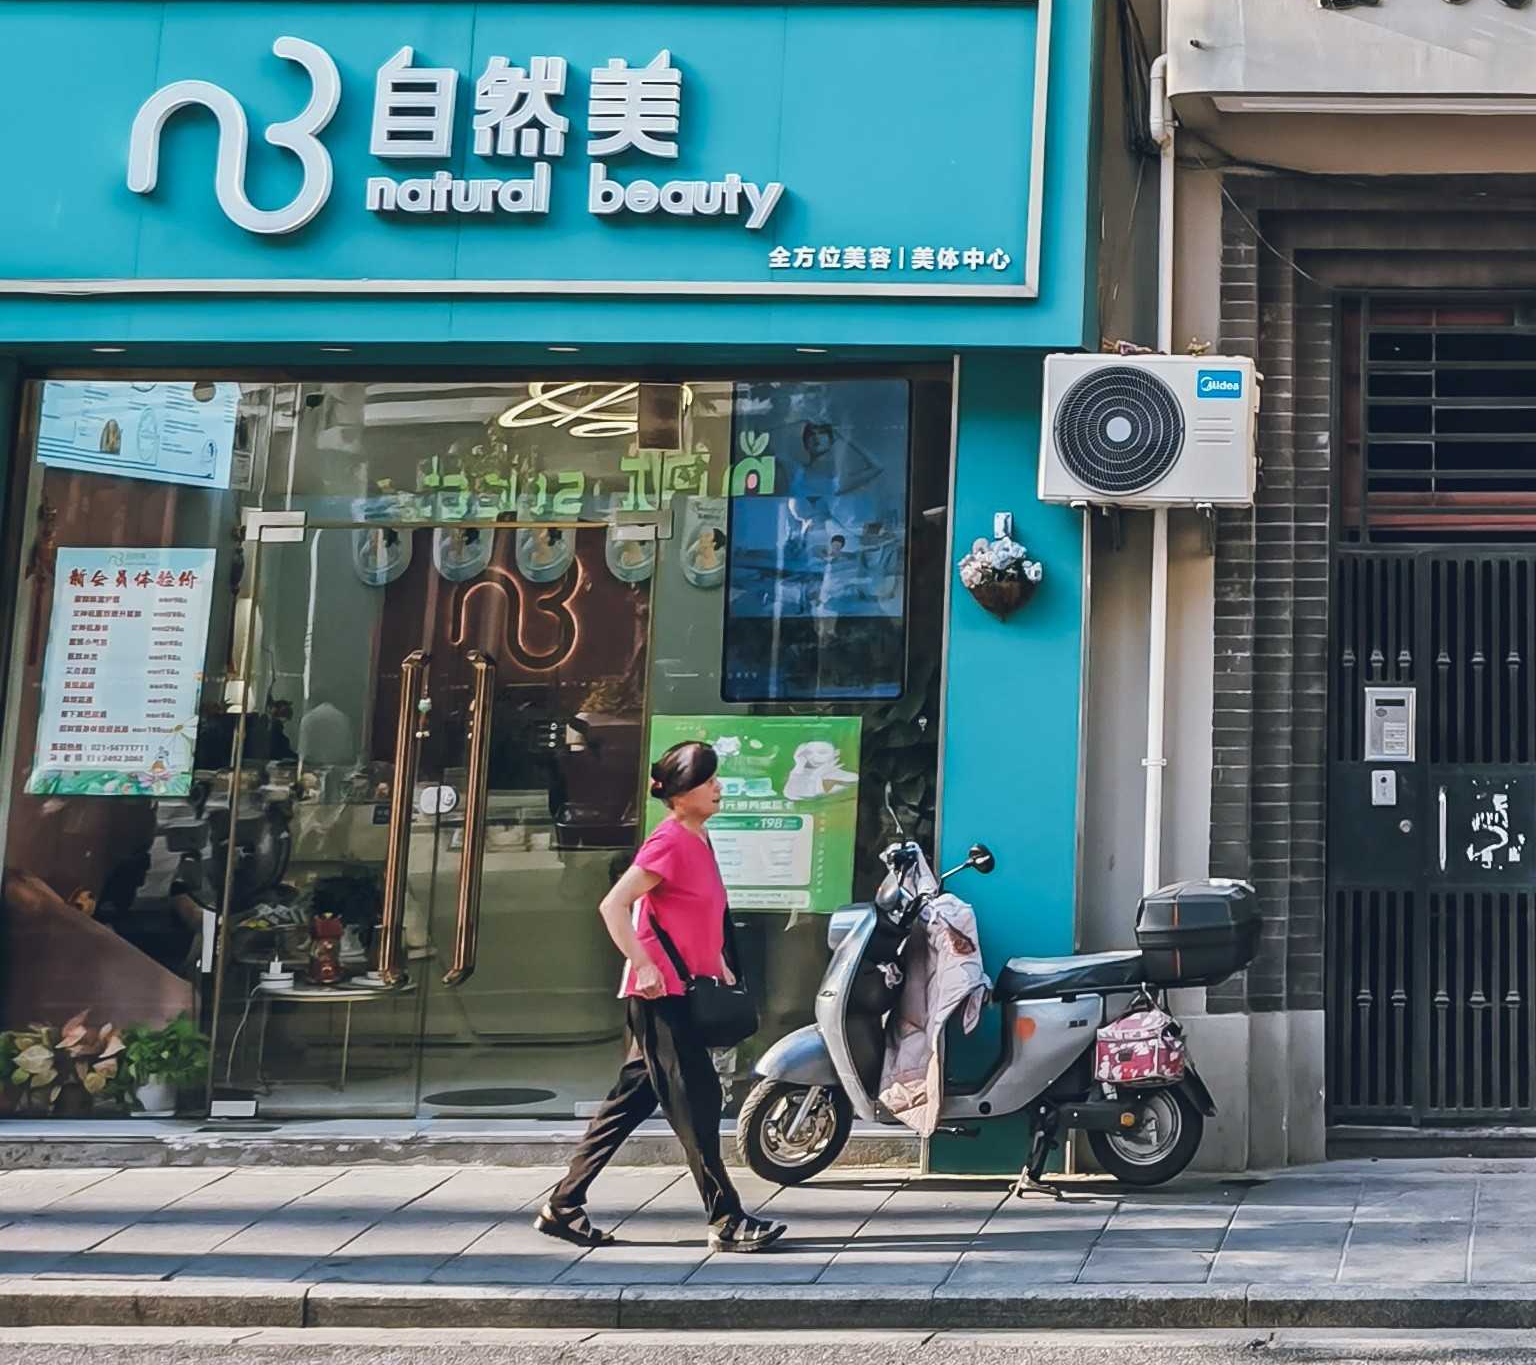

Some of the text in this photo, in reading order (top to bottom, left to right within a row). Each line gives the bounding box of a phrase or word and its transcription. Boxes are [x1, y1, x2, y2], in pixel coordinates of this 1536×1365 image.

[369, 46, 684, 160] 自然美
[365, 161, 786, 230] natural beauty
[768, 245, 1011, 271] 全方位美容 美体中心
[1200, 376, 1240, 391] Midea
[760, 817, 784, 829] 198
